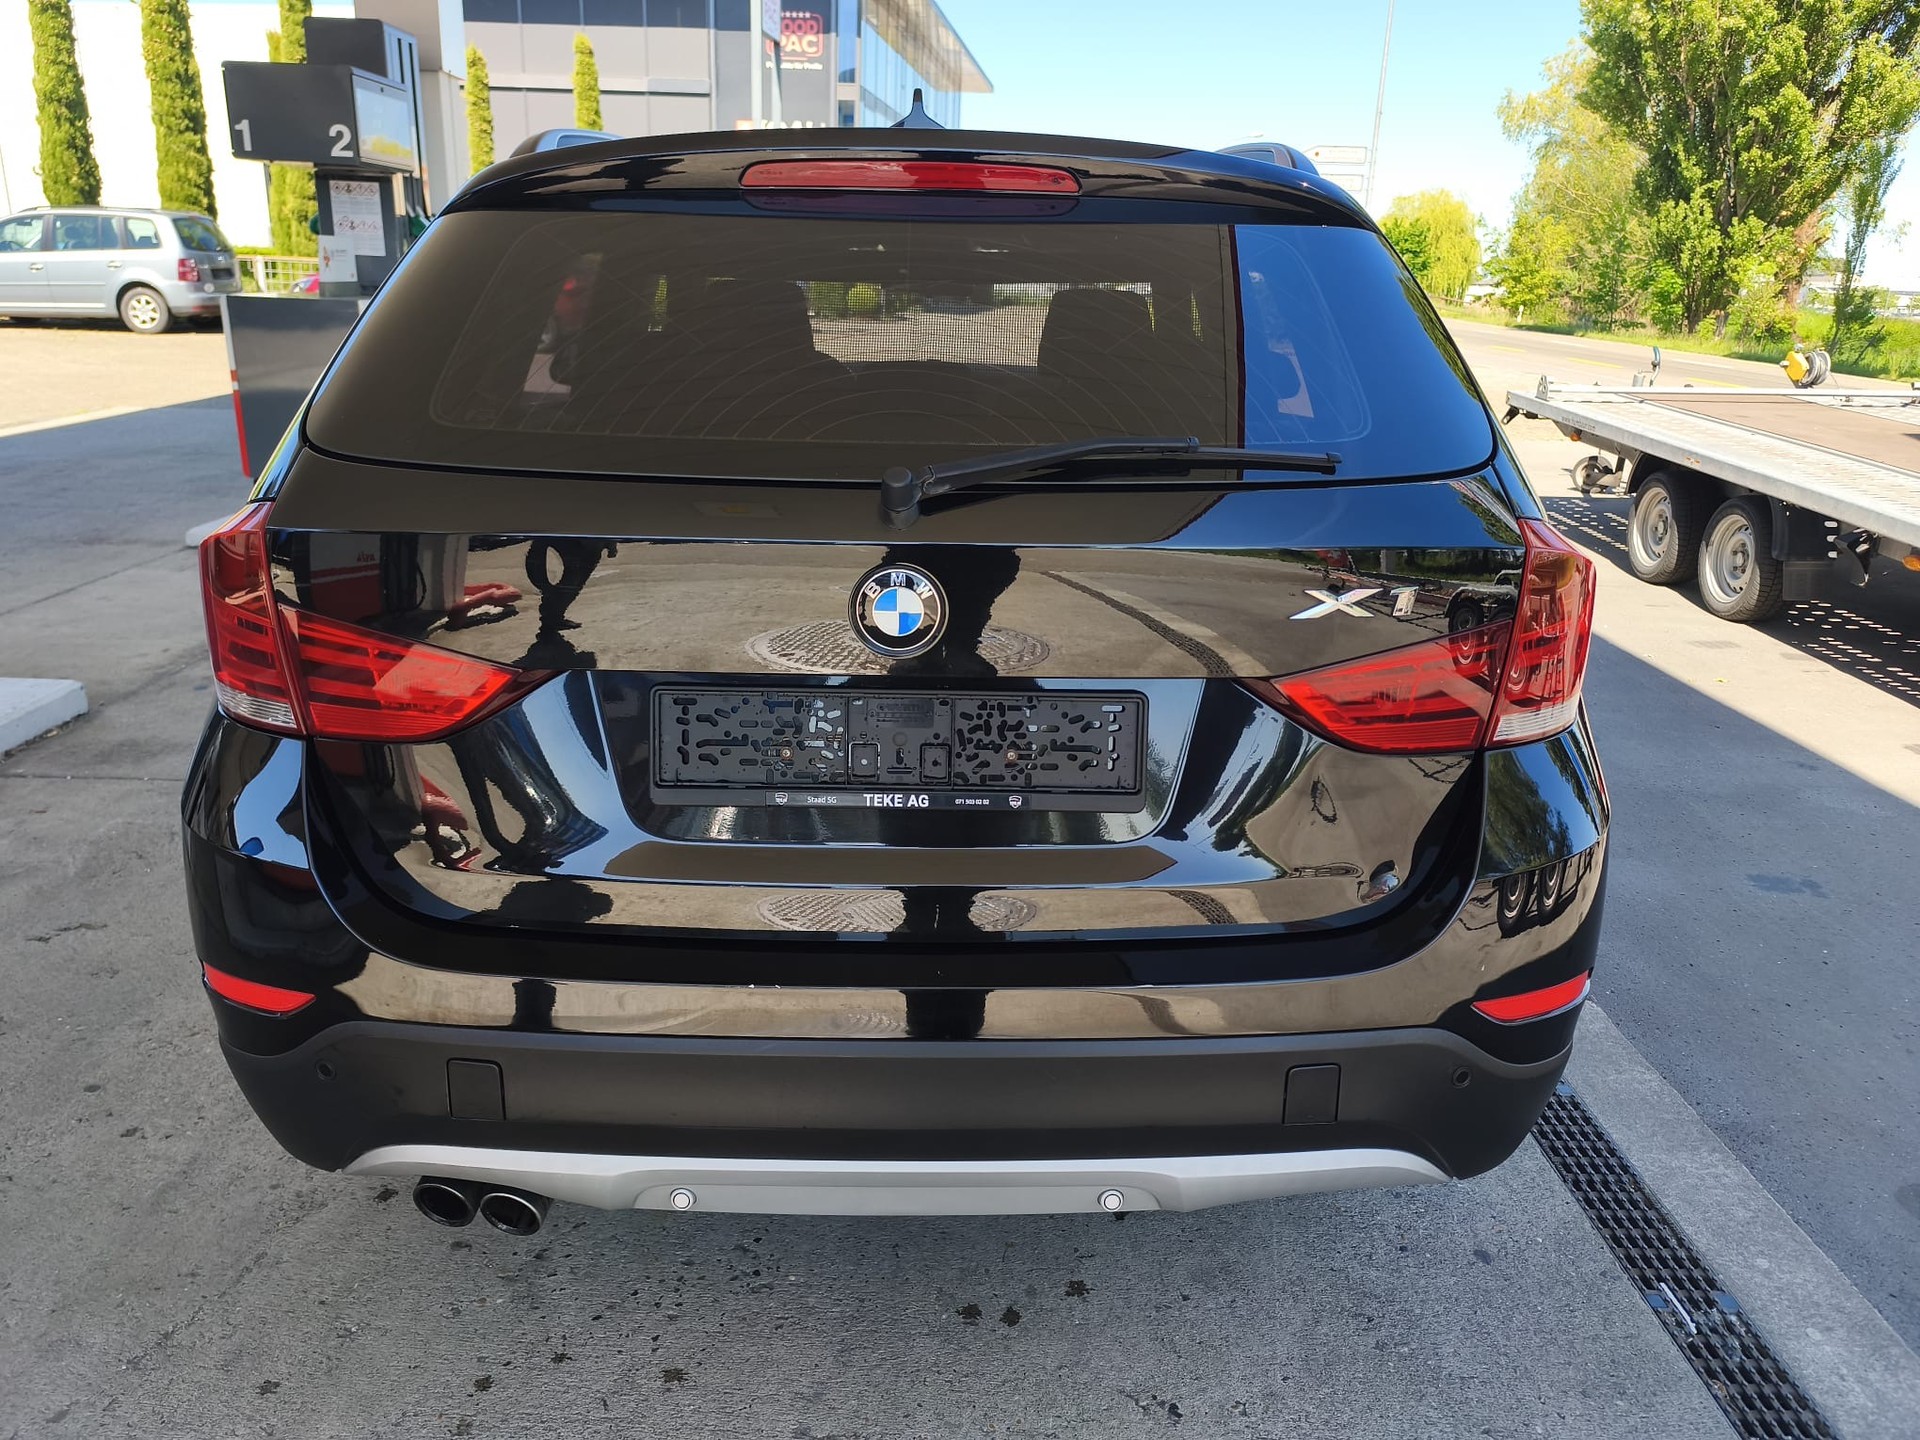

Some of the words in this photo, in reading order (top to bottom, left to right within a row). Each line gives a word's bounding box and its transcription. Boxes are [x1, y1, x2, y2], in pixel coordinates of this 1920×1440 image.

[234, 119, 252, 151] 1
[328, 123, 354, 157] 2
[864, 572, 934, 600] BMW
[1289, 586, 1420, 620] X1
[863, 793, 903, 807] TEKE
[907, 794, 930, 808] AG
